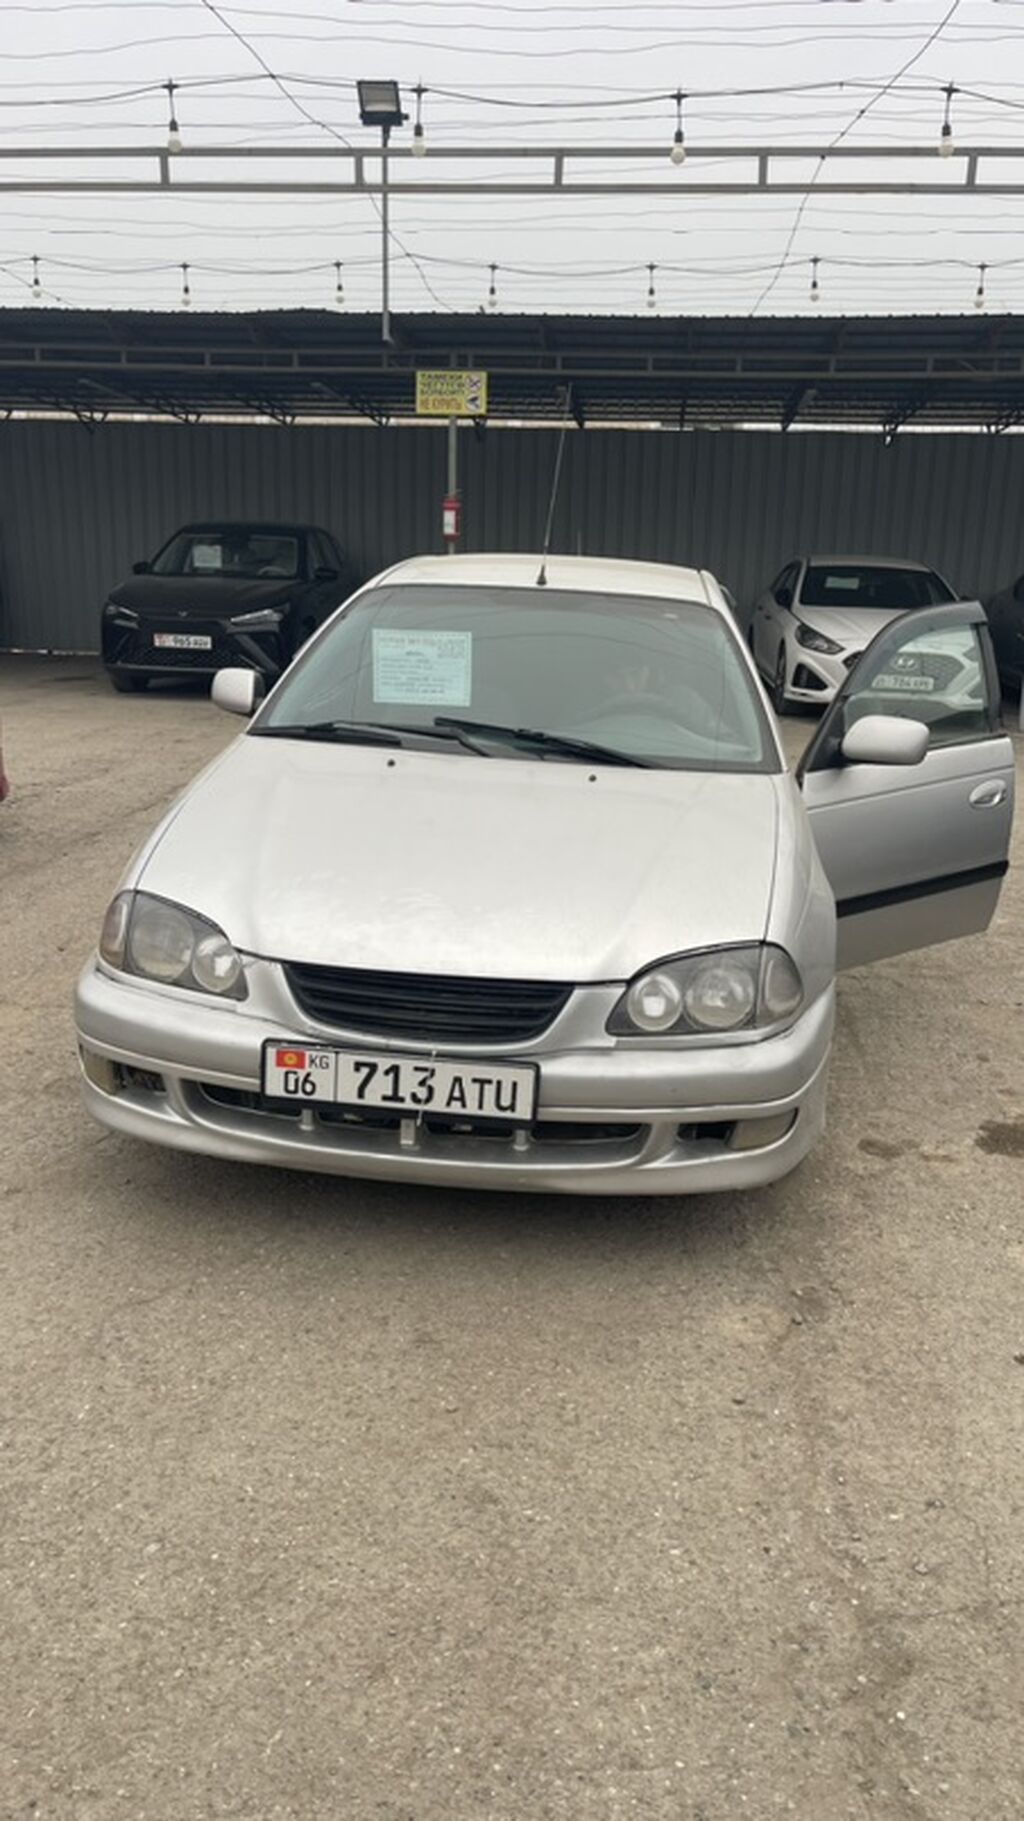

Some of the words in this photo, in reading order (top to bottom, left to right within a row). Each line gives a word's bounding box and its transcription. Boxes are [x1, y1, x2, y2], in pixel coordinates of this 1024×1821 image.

[309, 1055, 330, 1069] KG
[283, 1070, 317, 1096] 06
[354, 1061, 436, 1105] 713
[445, 1076, 518, 1113] ATU
